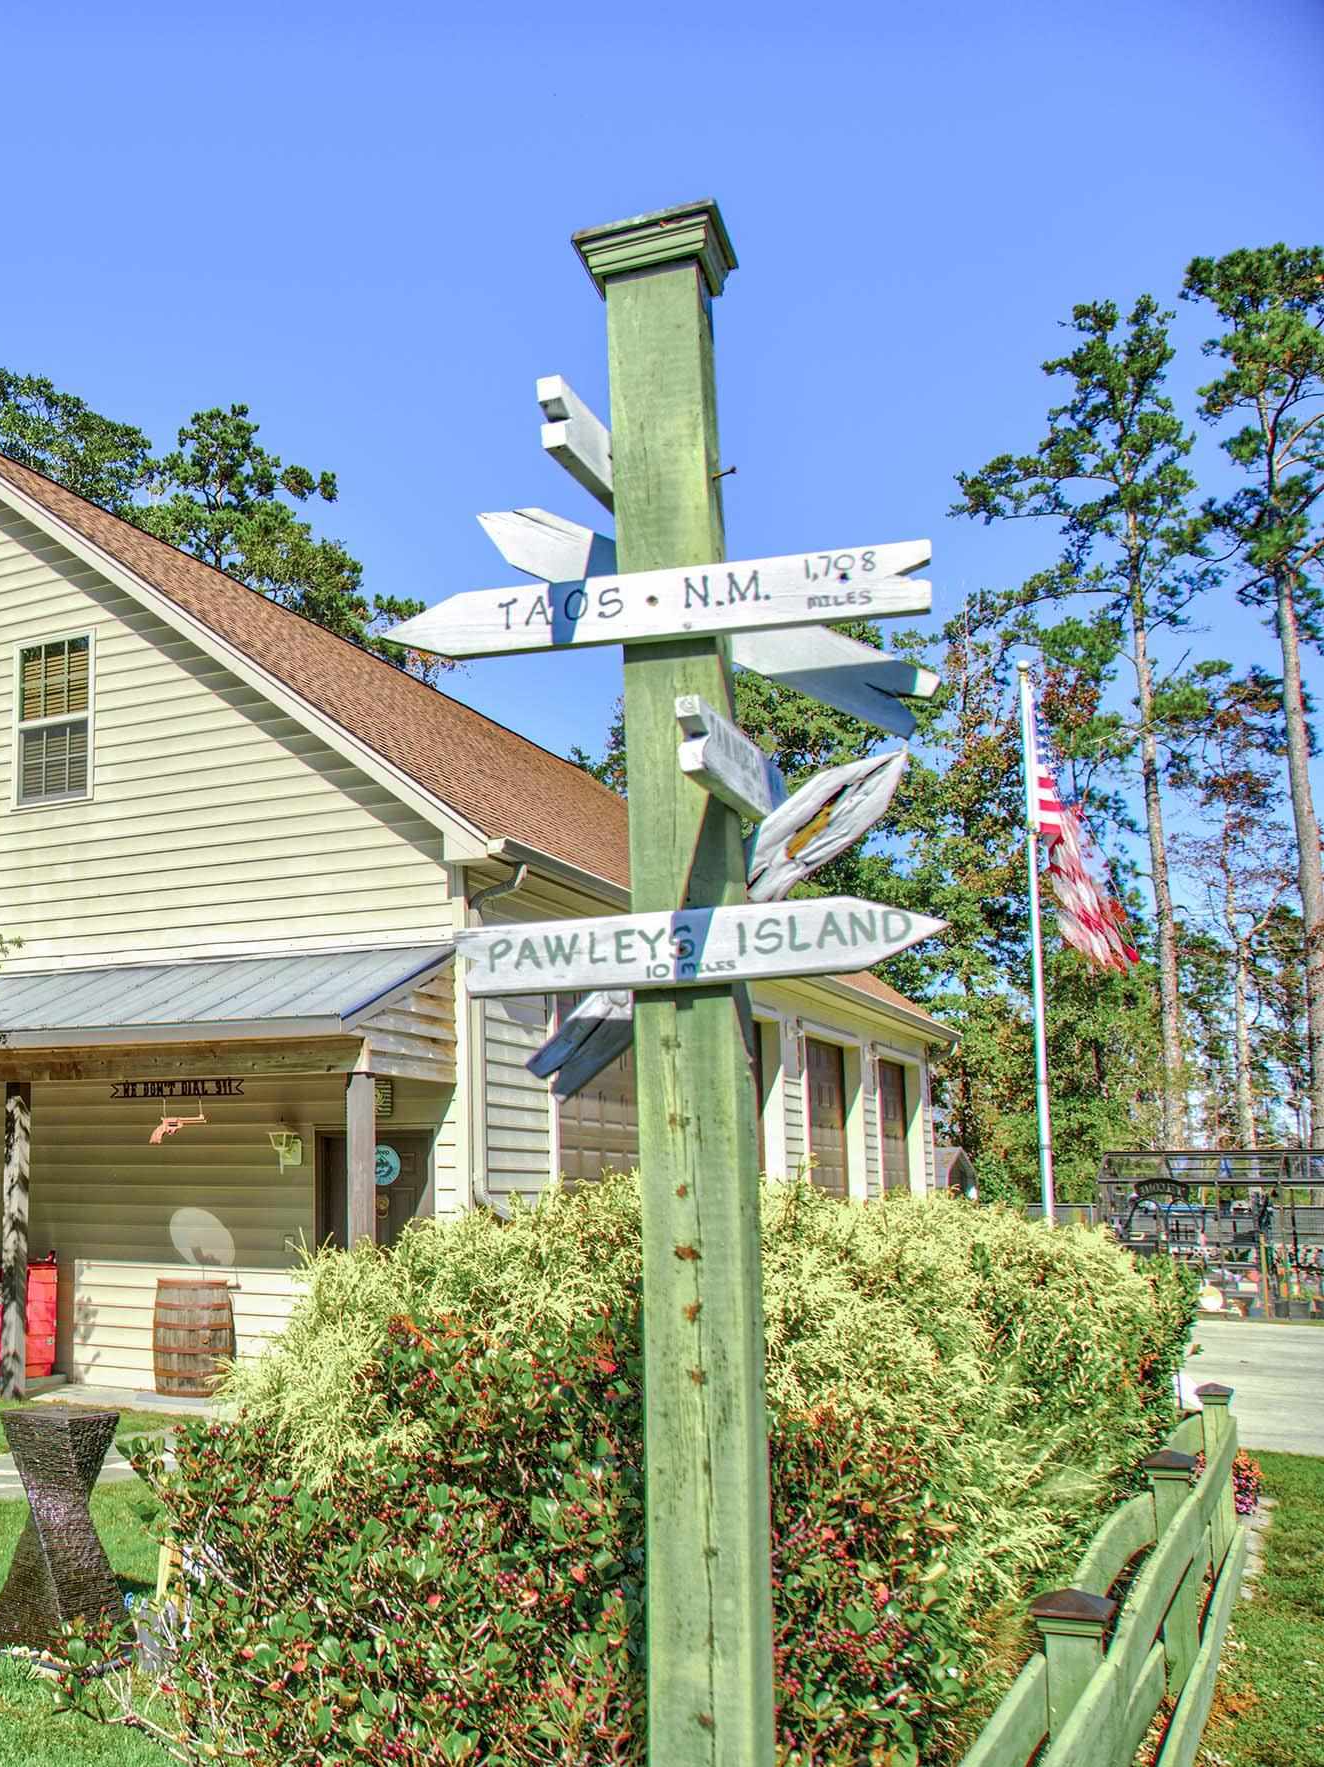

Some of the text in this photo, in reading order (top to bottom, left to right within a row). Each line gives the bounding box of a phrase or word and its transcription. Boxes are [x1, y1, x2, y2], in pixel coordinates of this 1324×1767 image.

[498, 551, 876, 630] TAOS N.M. 1,708
[487, 909, 913, 973] PAWLEYS ISLAND
[646, 964, 670, 979] 10
